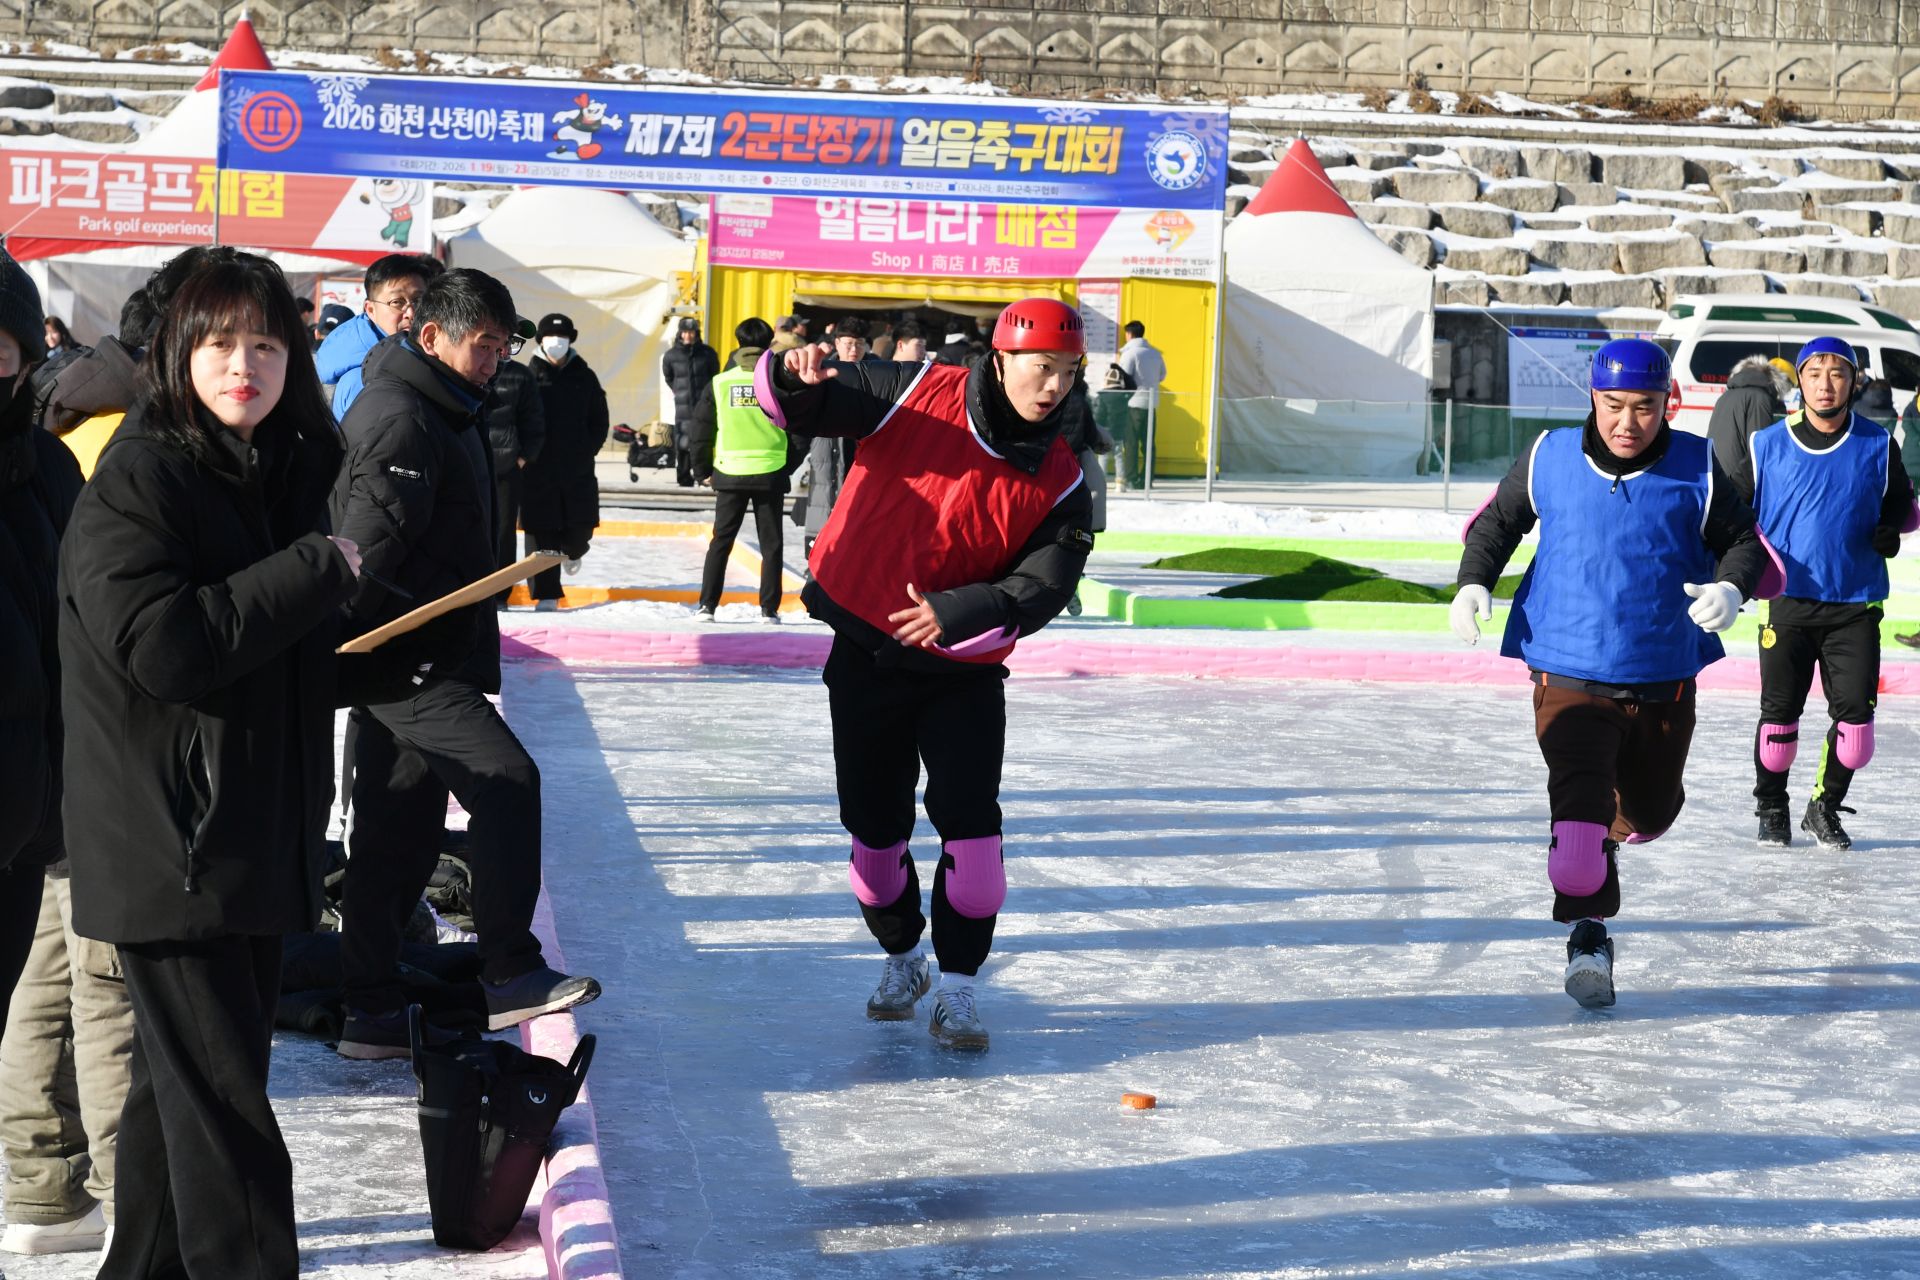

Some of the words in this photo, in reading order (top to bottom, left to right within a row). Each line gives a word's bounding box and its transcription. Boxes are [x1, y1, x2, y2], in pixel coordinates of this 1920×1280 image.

[323, 103, 375, 131] 2026
[378, 104, 424, 139] 화천
[625, 114, 716, 158] 제7회
[720, 111, 894, 166] 2군단장기
[900, 118, 1124, 175] 얼음축구대회
[79, 215, 111, 232] Park
[113, 217, 140, 236] golf
[142, 220, 216, 238] experience
[815, 198, 983, 246] 얼음나라
[995, 203, 1078, 249] 매점
[871, 250, 911, 271] Shop
[931, 255, 964, 273] 商店
[984, 256, 1020, 275] 売店
[732, 386, 755, 397] 안전
